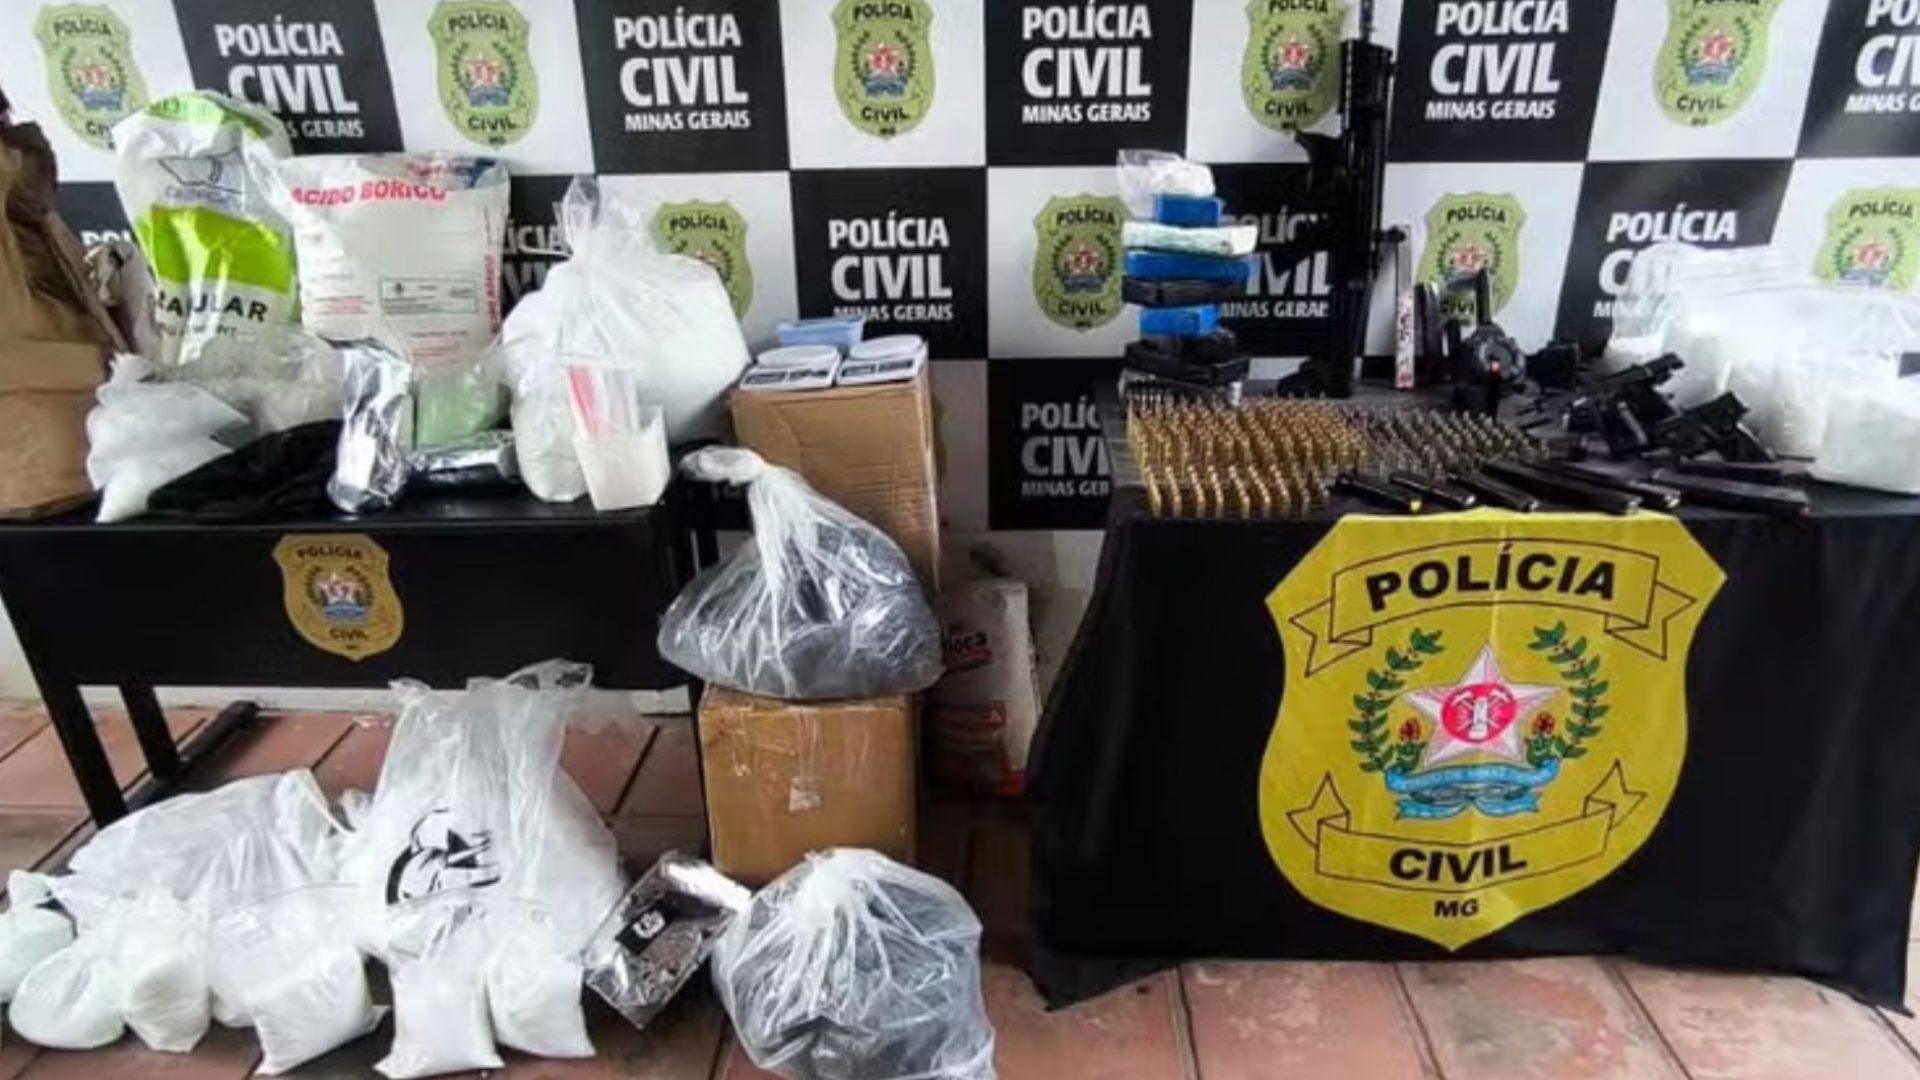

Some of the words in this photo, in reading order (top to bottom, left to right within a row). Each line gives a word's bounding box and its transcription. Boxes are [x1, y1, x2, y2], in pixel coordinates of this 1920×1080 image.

[448, 9, 508, 33] POLÍCIA
[614, 7, 742, 50] POLÍCIA
[1023, 0, 1151, 40] POLÍCIA
[215, 15, 343, 57] POLÍCIA
[1022, 47, 1151, 99] CIVIL
[1430, 42, 1561, 95] CIVIL
[228, 64, 358, 115] CIVIL
[620, 55, 748, 108] CIVIL
[861, 106, 911, 121] CIVIL
[1022, 105, 1082, 123] MINAS
[1087, 103, 1151, 122] GERAIS
[1265, 99, 1314, 117] CIVIL
[1425, 101, 1486, 121] MINAS
[1490, 99, 1556, 119] GERAIS
[1677, 94, 1726, 112] CIVIL
[302, 120, 365, 138] GERAIS
[468, 116, 518, 132] CIVIL
[625, 113, 684, 131] MINAS
[688, 110, 751, 129] GERAIS
[670, 211, 728, 233] POLÍCIA
[1056, 205, 1116, 227] POLÍCIA
[1446, 203, 1506, 223] POLÍCIA
[1607, 202, 1737, 243] POLÍCIA
[828, 210, 950, 249] POLÍCIA
[831, 255, 952, 302] CIVIL
[893, 304, 953, 321] GERAIS
[1057, 301, 1106, 317] CIVIL
[1022, 436, 1109, 476] CIVI
[1366, 544, 1616, 612] POLÍCIA
[1390, 844, 1528, 884] CIVIL
[1434, 900, 1479, 918] MG
